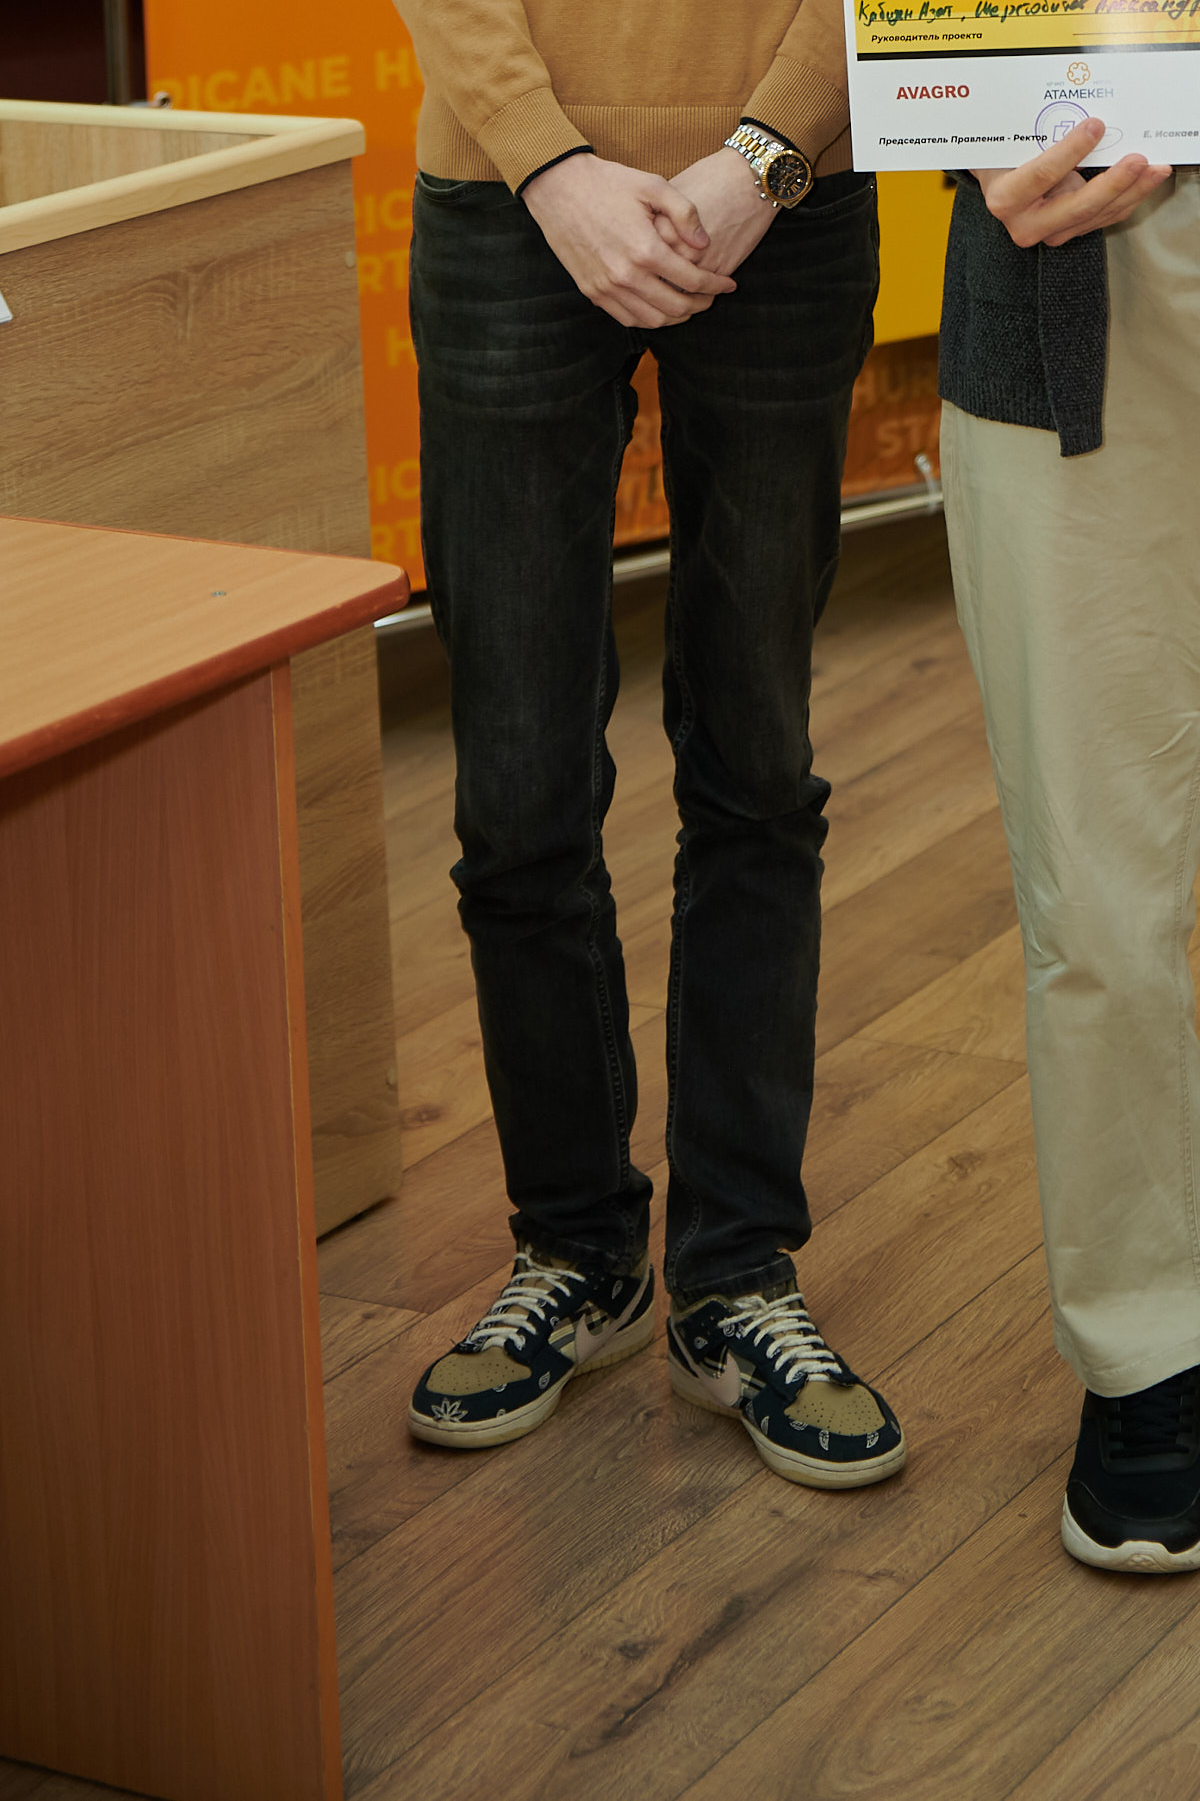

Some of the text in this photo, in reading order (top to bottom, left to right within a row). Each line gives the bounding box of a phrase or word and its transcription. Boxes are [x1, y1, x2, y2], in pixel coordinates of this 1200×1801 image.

[871, 32, 983, 44] Руководитель проекта
[896, 84, 970, 100] AVAGRO
[1043, 87, 1114, 100] АТАМЕКЕН
[879, 135, 949, 146] Председатель
[951, 133, 1004, 145] Правления
[1013, 133, 1047, 145] Ректор
[1155, 129, 1199, 138] Исакаев
